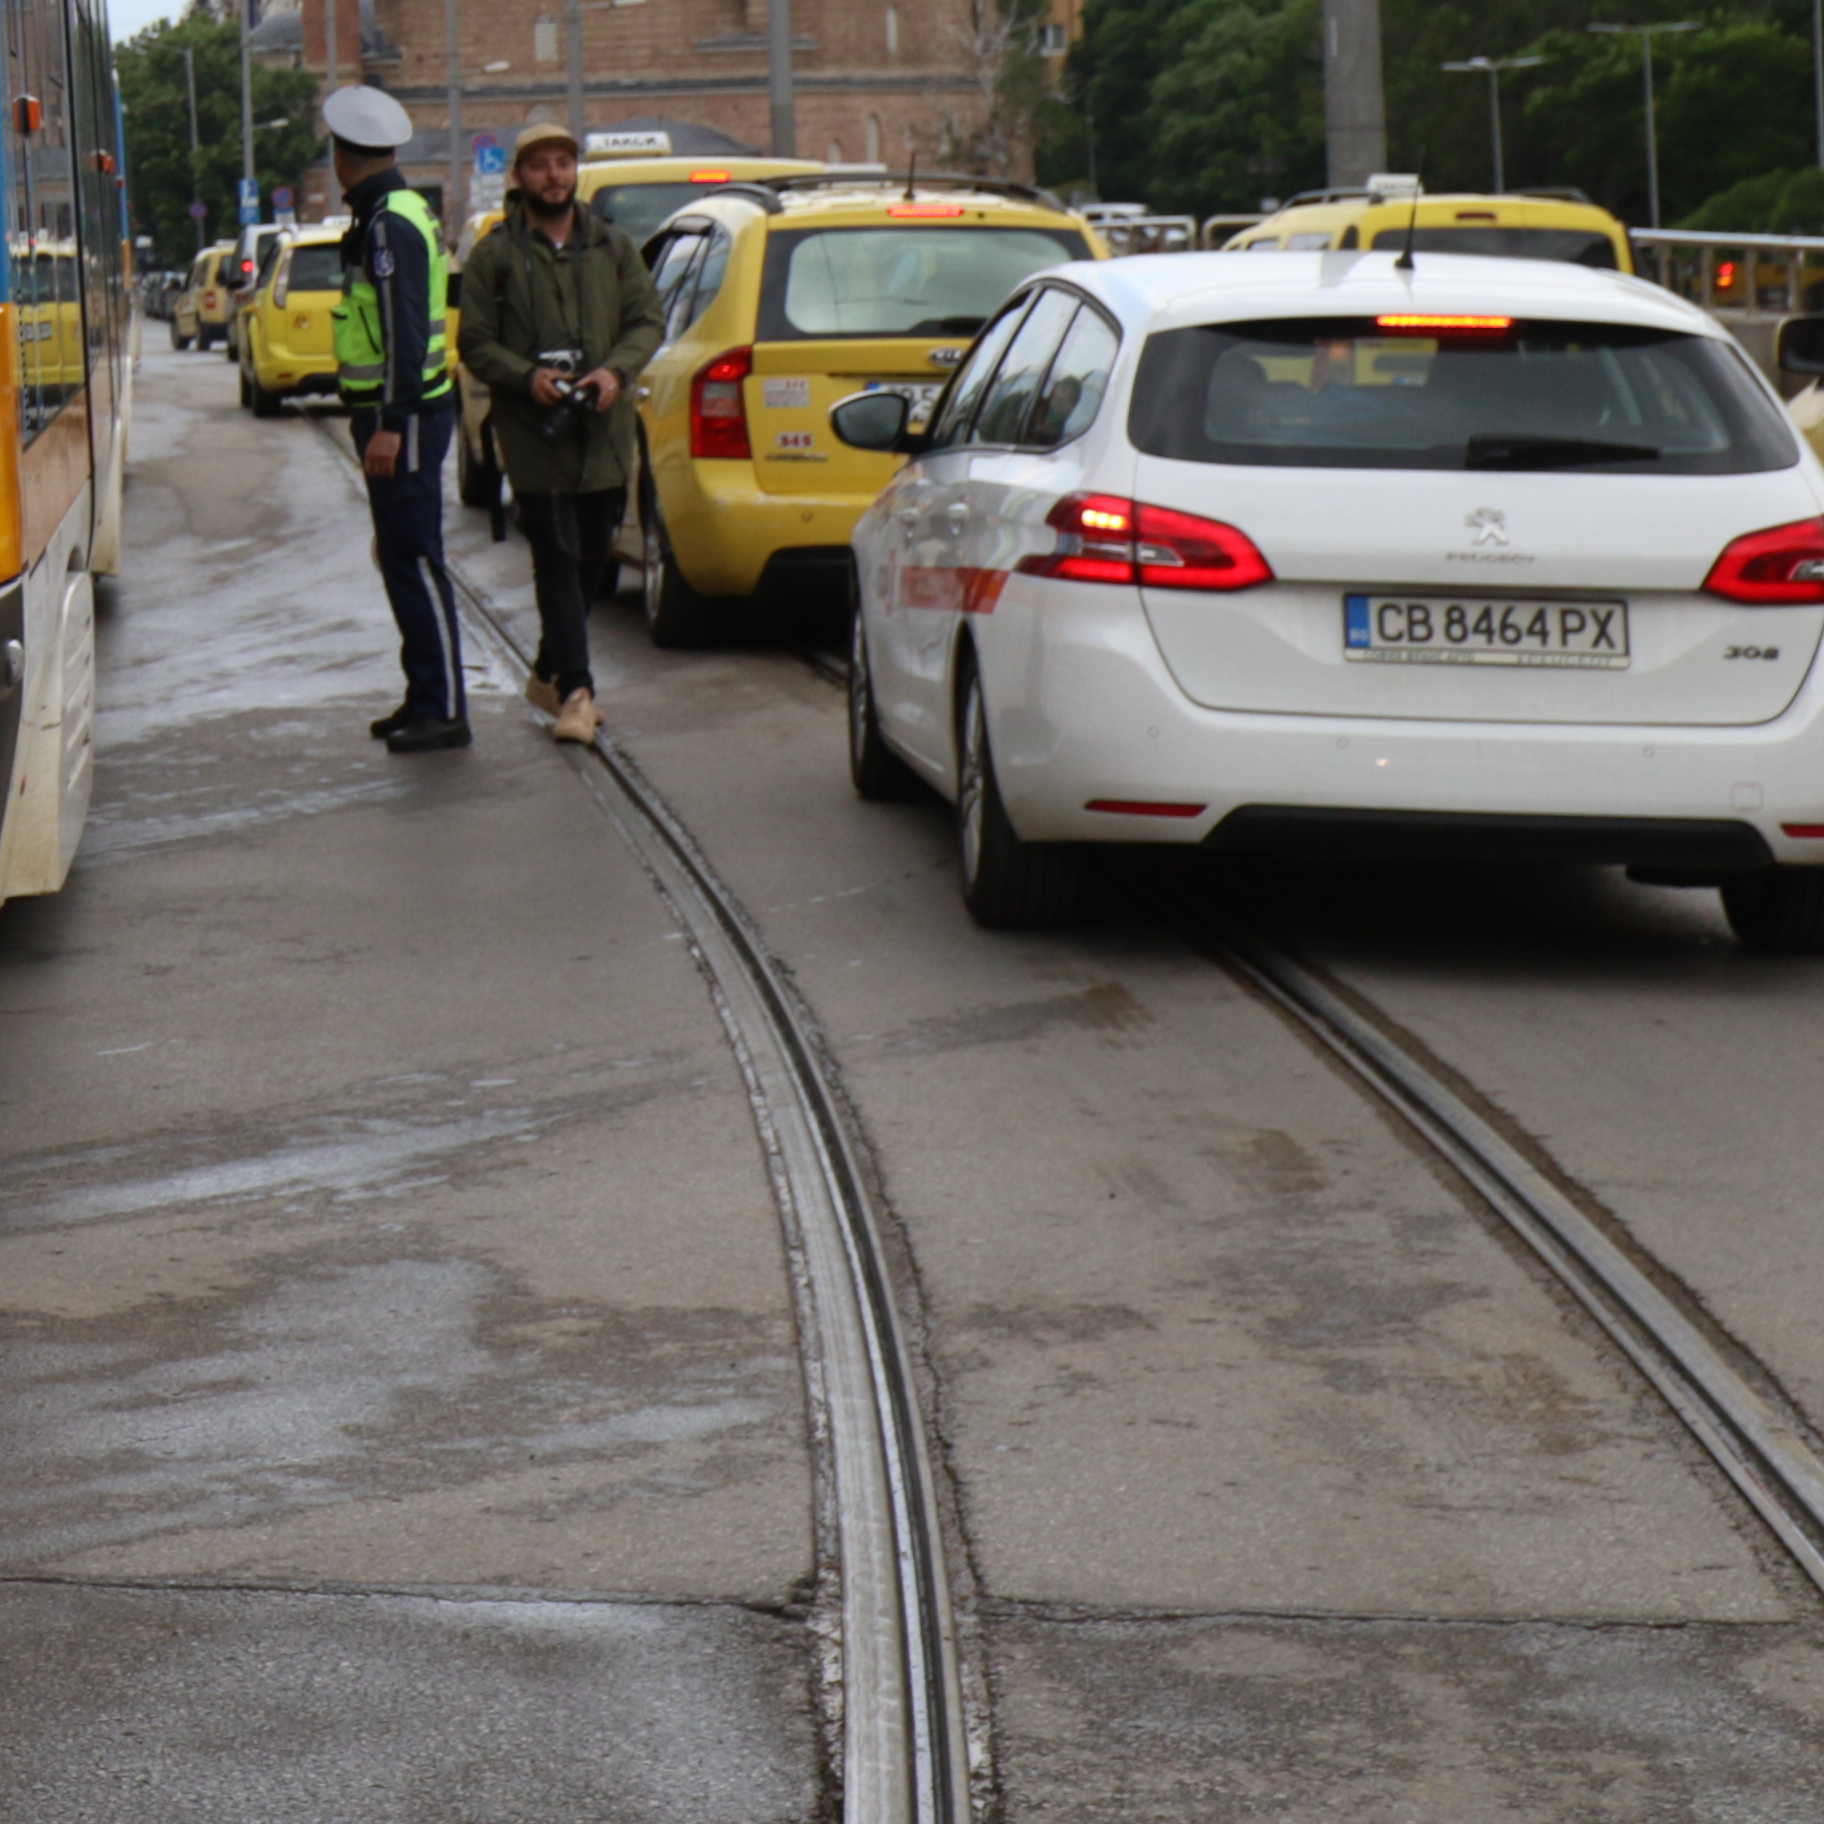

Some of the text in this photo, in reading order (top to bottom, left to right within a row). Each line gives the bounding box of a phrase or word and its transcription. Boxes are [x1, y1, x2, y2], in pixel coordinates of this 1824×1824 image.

[603, 136, 656, 149] ТАКСИ
[1446, 551, 1536, 564] PEUGEOT
[1377, 603, 1616, 650] CB 8464 PX
[1722, 644, 1780, 662] 308
